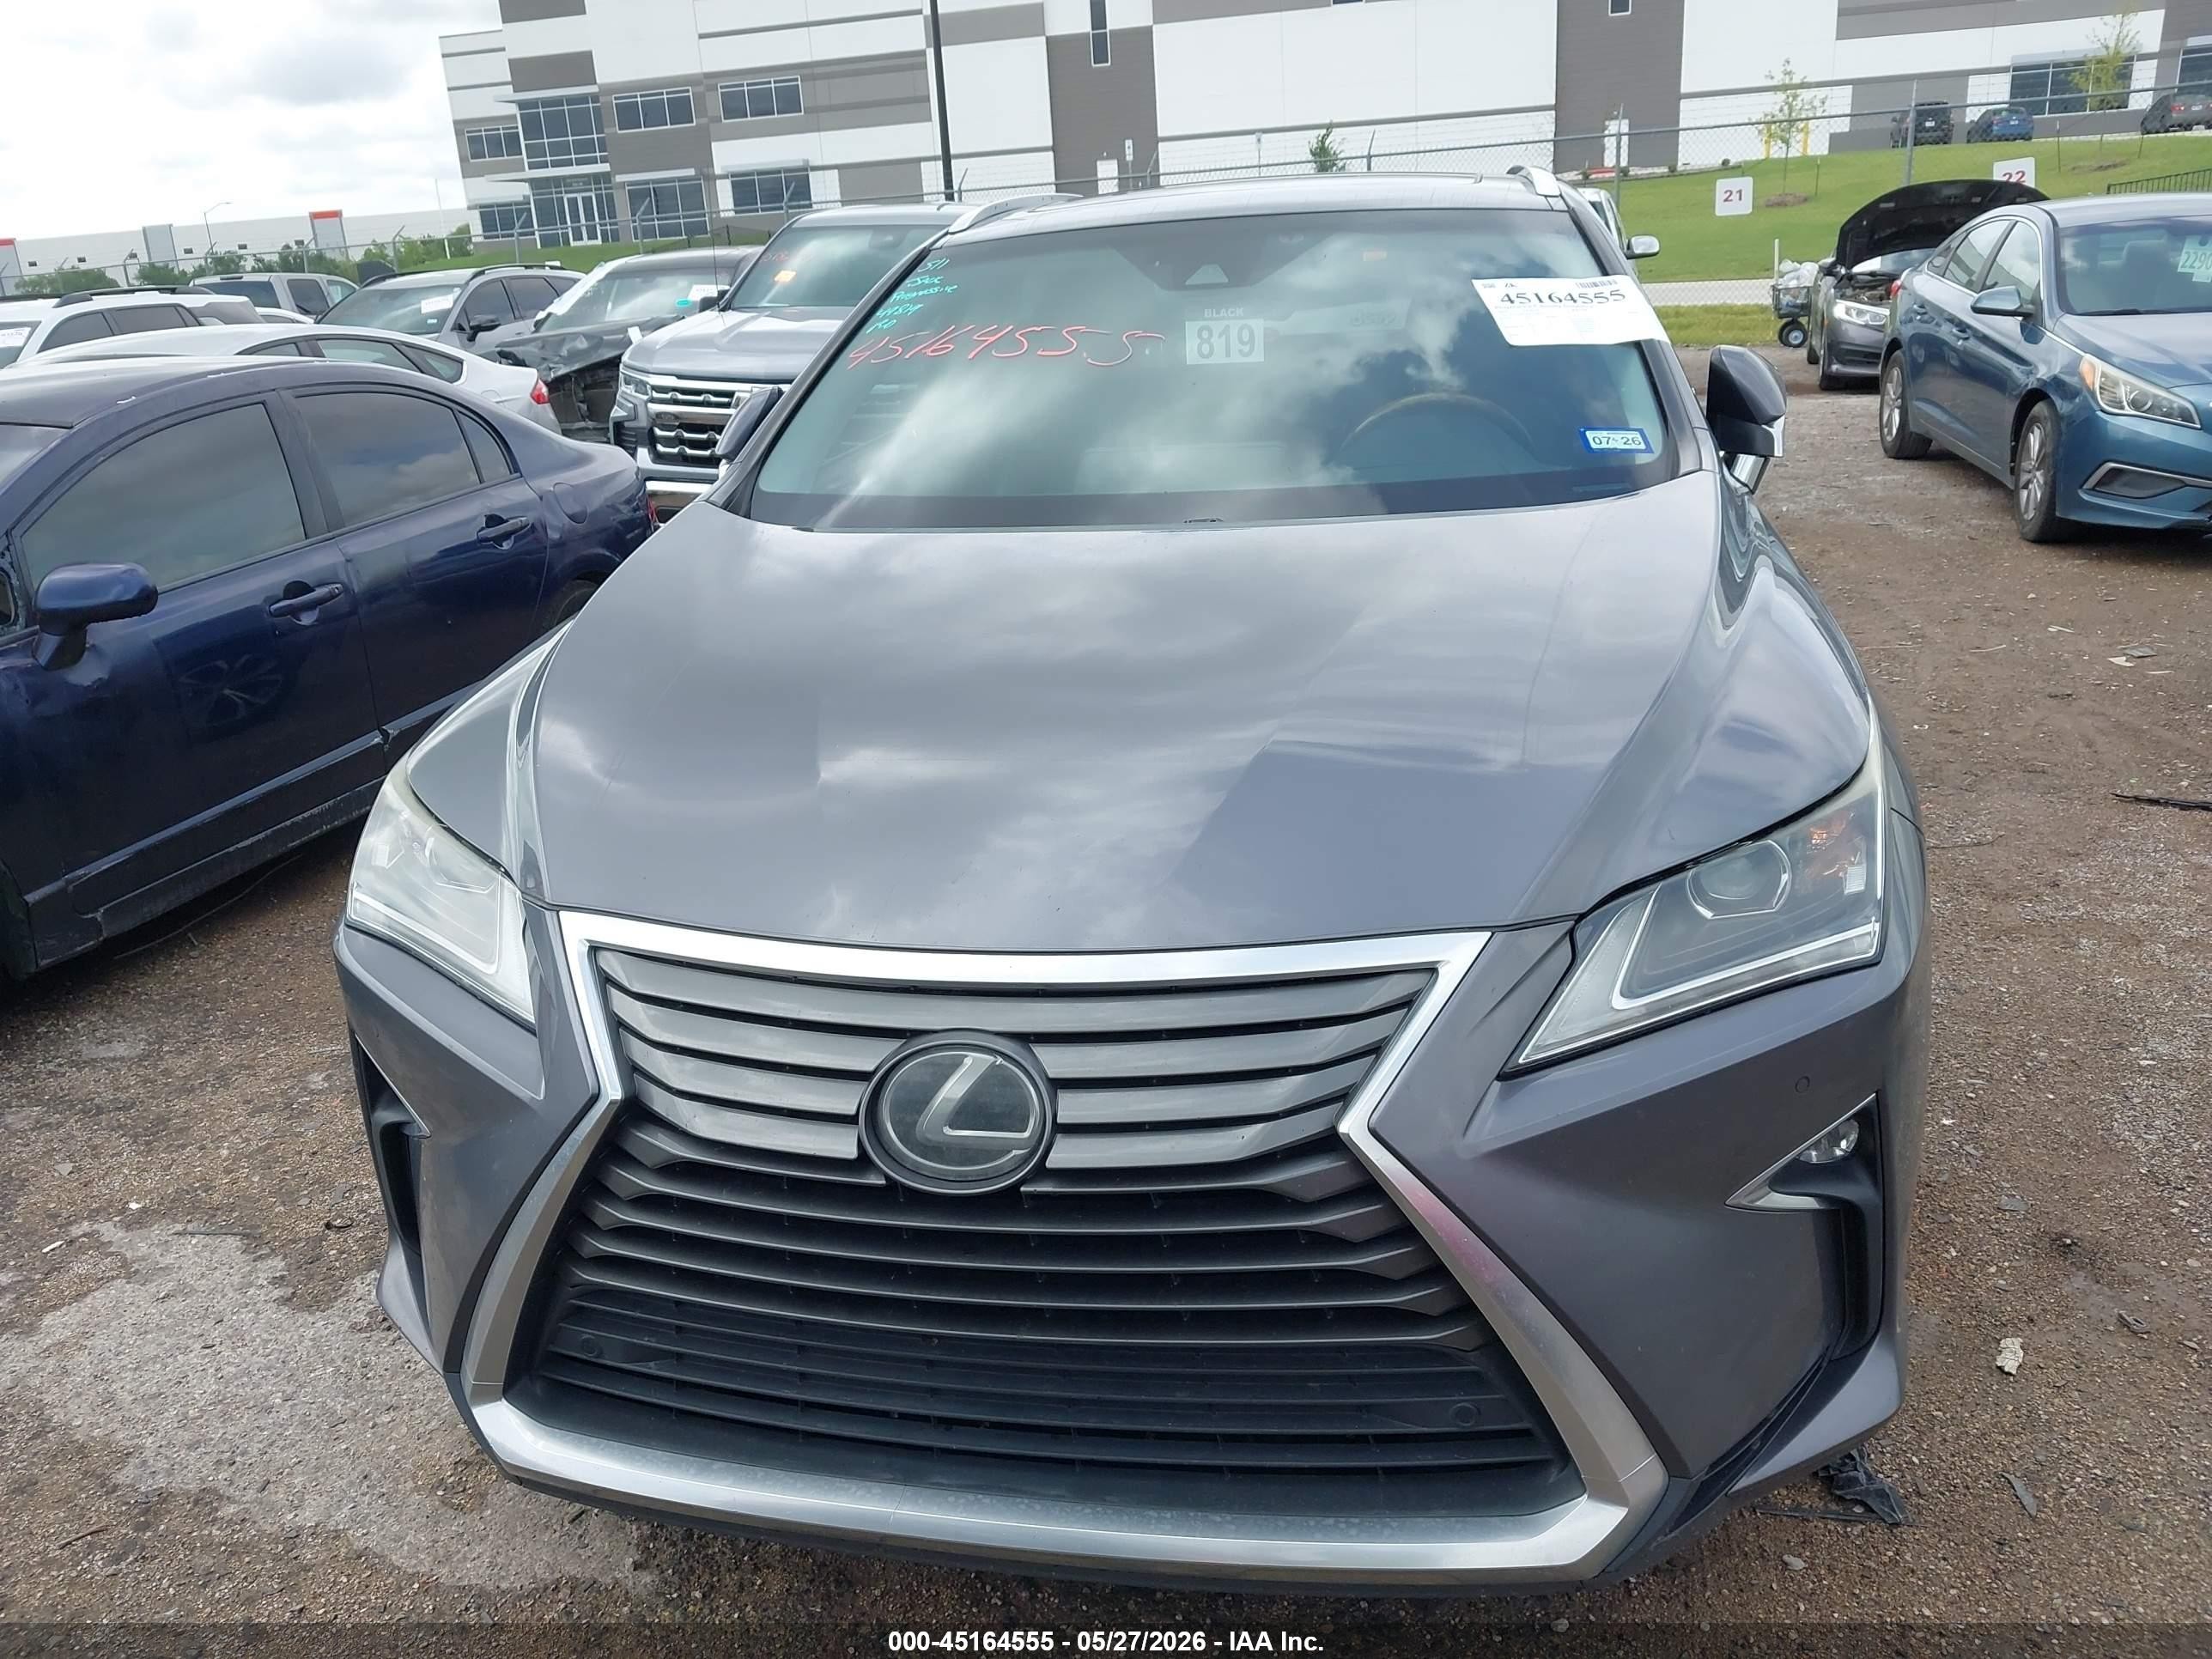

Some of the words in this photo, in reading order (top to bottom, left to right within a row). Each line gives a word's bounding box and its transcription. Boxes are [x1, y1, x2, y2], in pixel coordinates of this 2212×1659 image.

[1723, 188, 1743, 203] 21
[1500, 289, 1626, 304] 45164555
[1204, 308, 1244, 317] BLACK
[847, 325, 1166, 369] 45164555
[1197, 324, 1255, 359] 819
